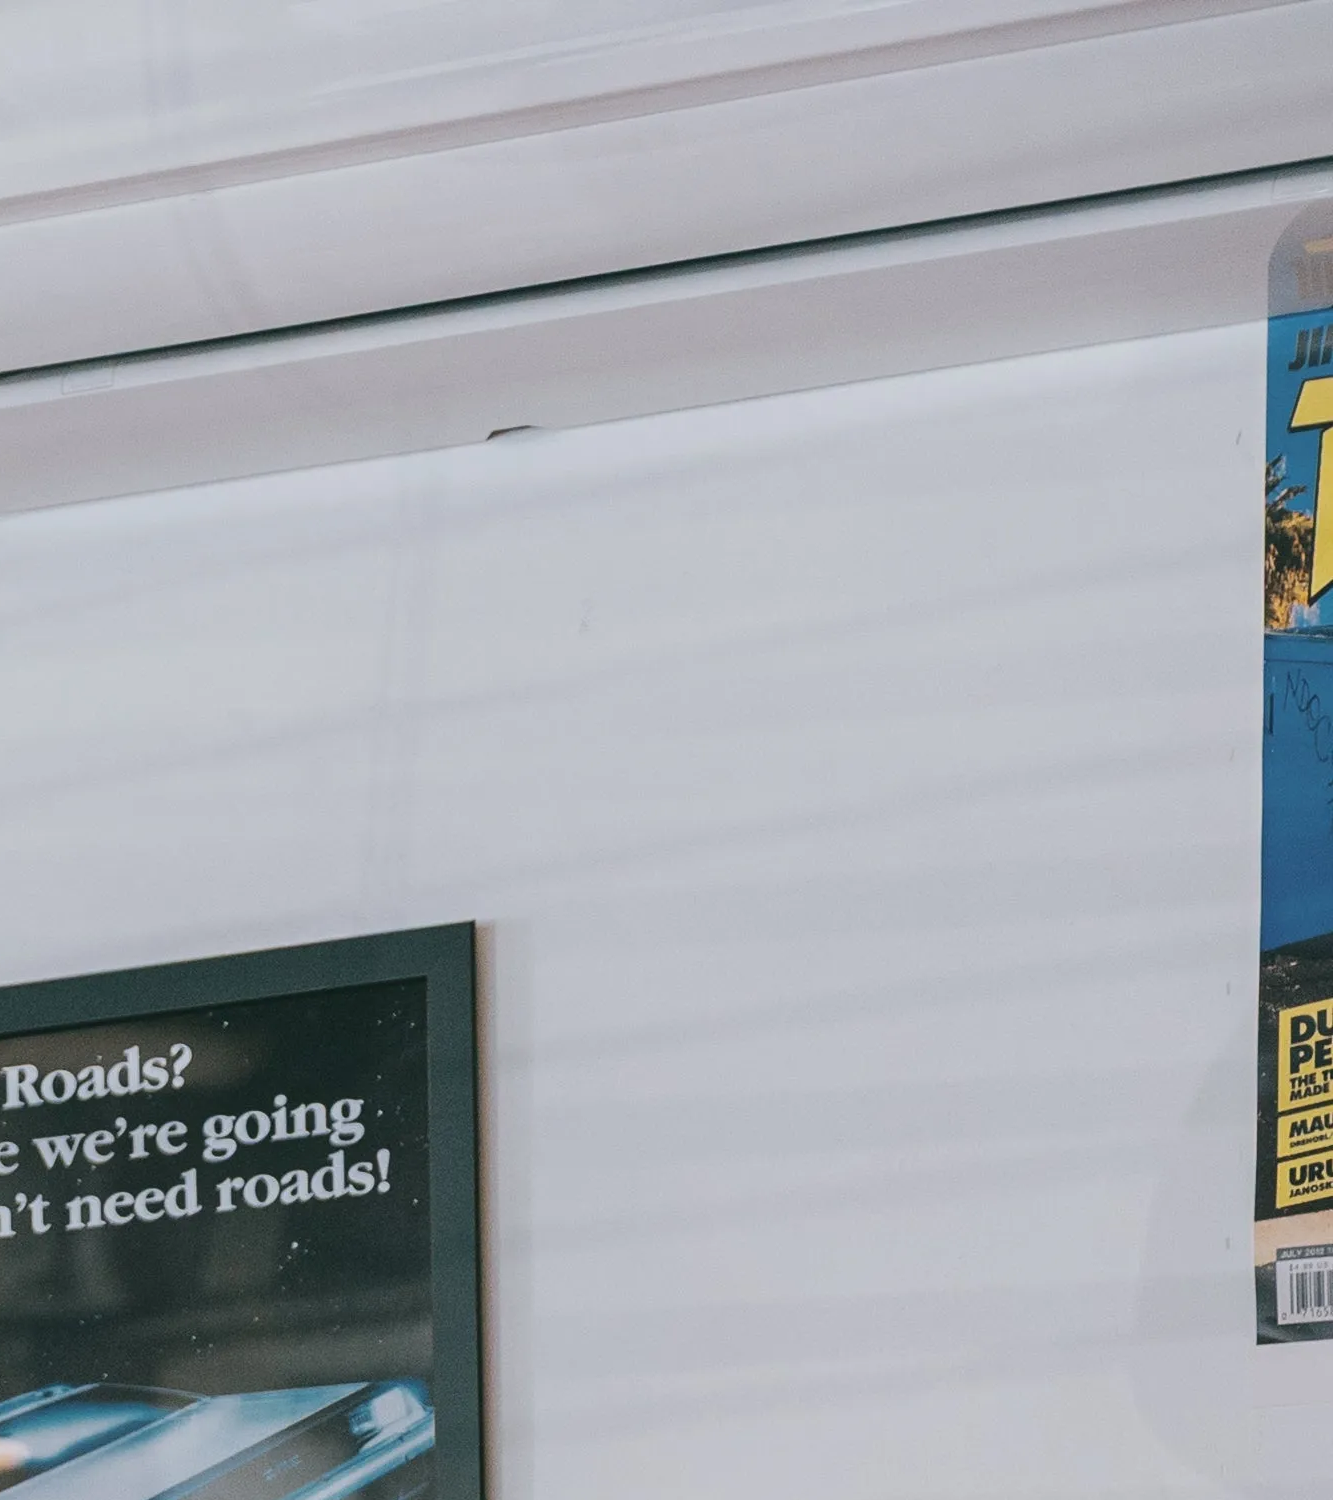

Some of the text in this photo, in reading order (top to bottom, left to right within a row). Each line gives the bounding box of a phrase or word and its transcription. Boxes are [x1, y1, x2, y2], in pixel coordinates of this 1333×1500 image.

[0, 1043, 194, 1112] Roads?
[1289, 1073, 1316, 1089] THE
[1290, 1083, 1330, 1102] MADE
[33, 1117, 188, 1167] we're
[202, 1093, 366, 1163] going
[65, 1168, 201, 1232] need
[216, 1150, 393, 1213] roads!
[1281, 1248, 1302, 1258] JULY
